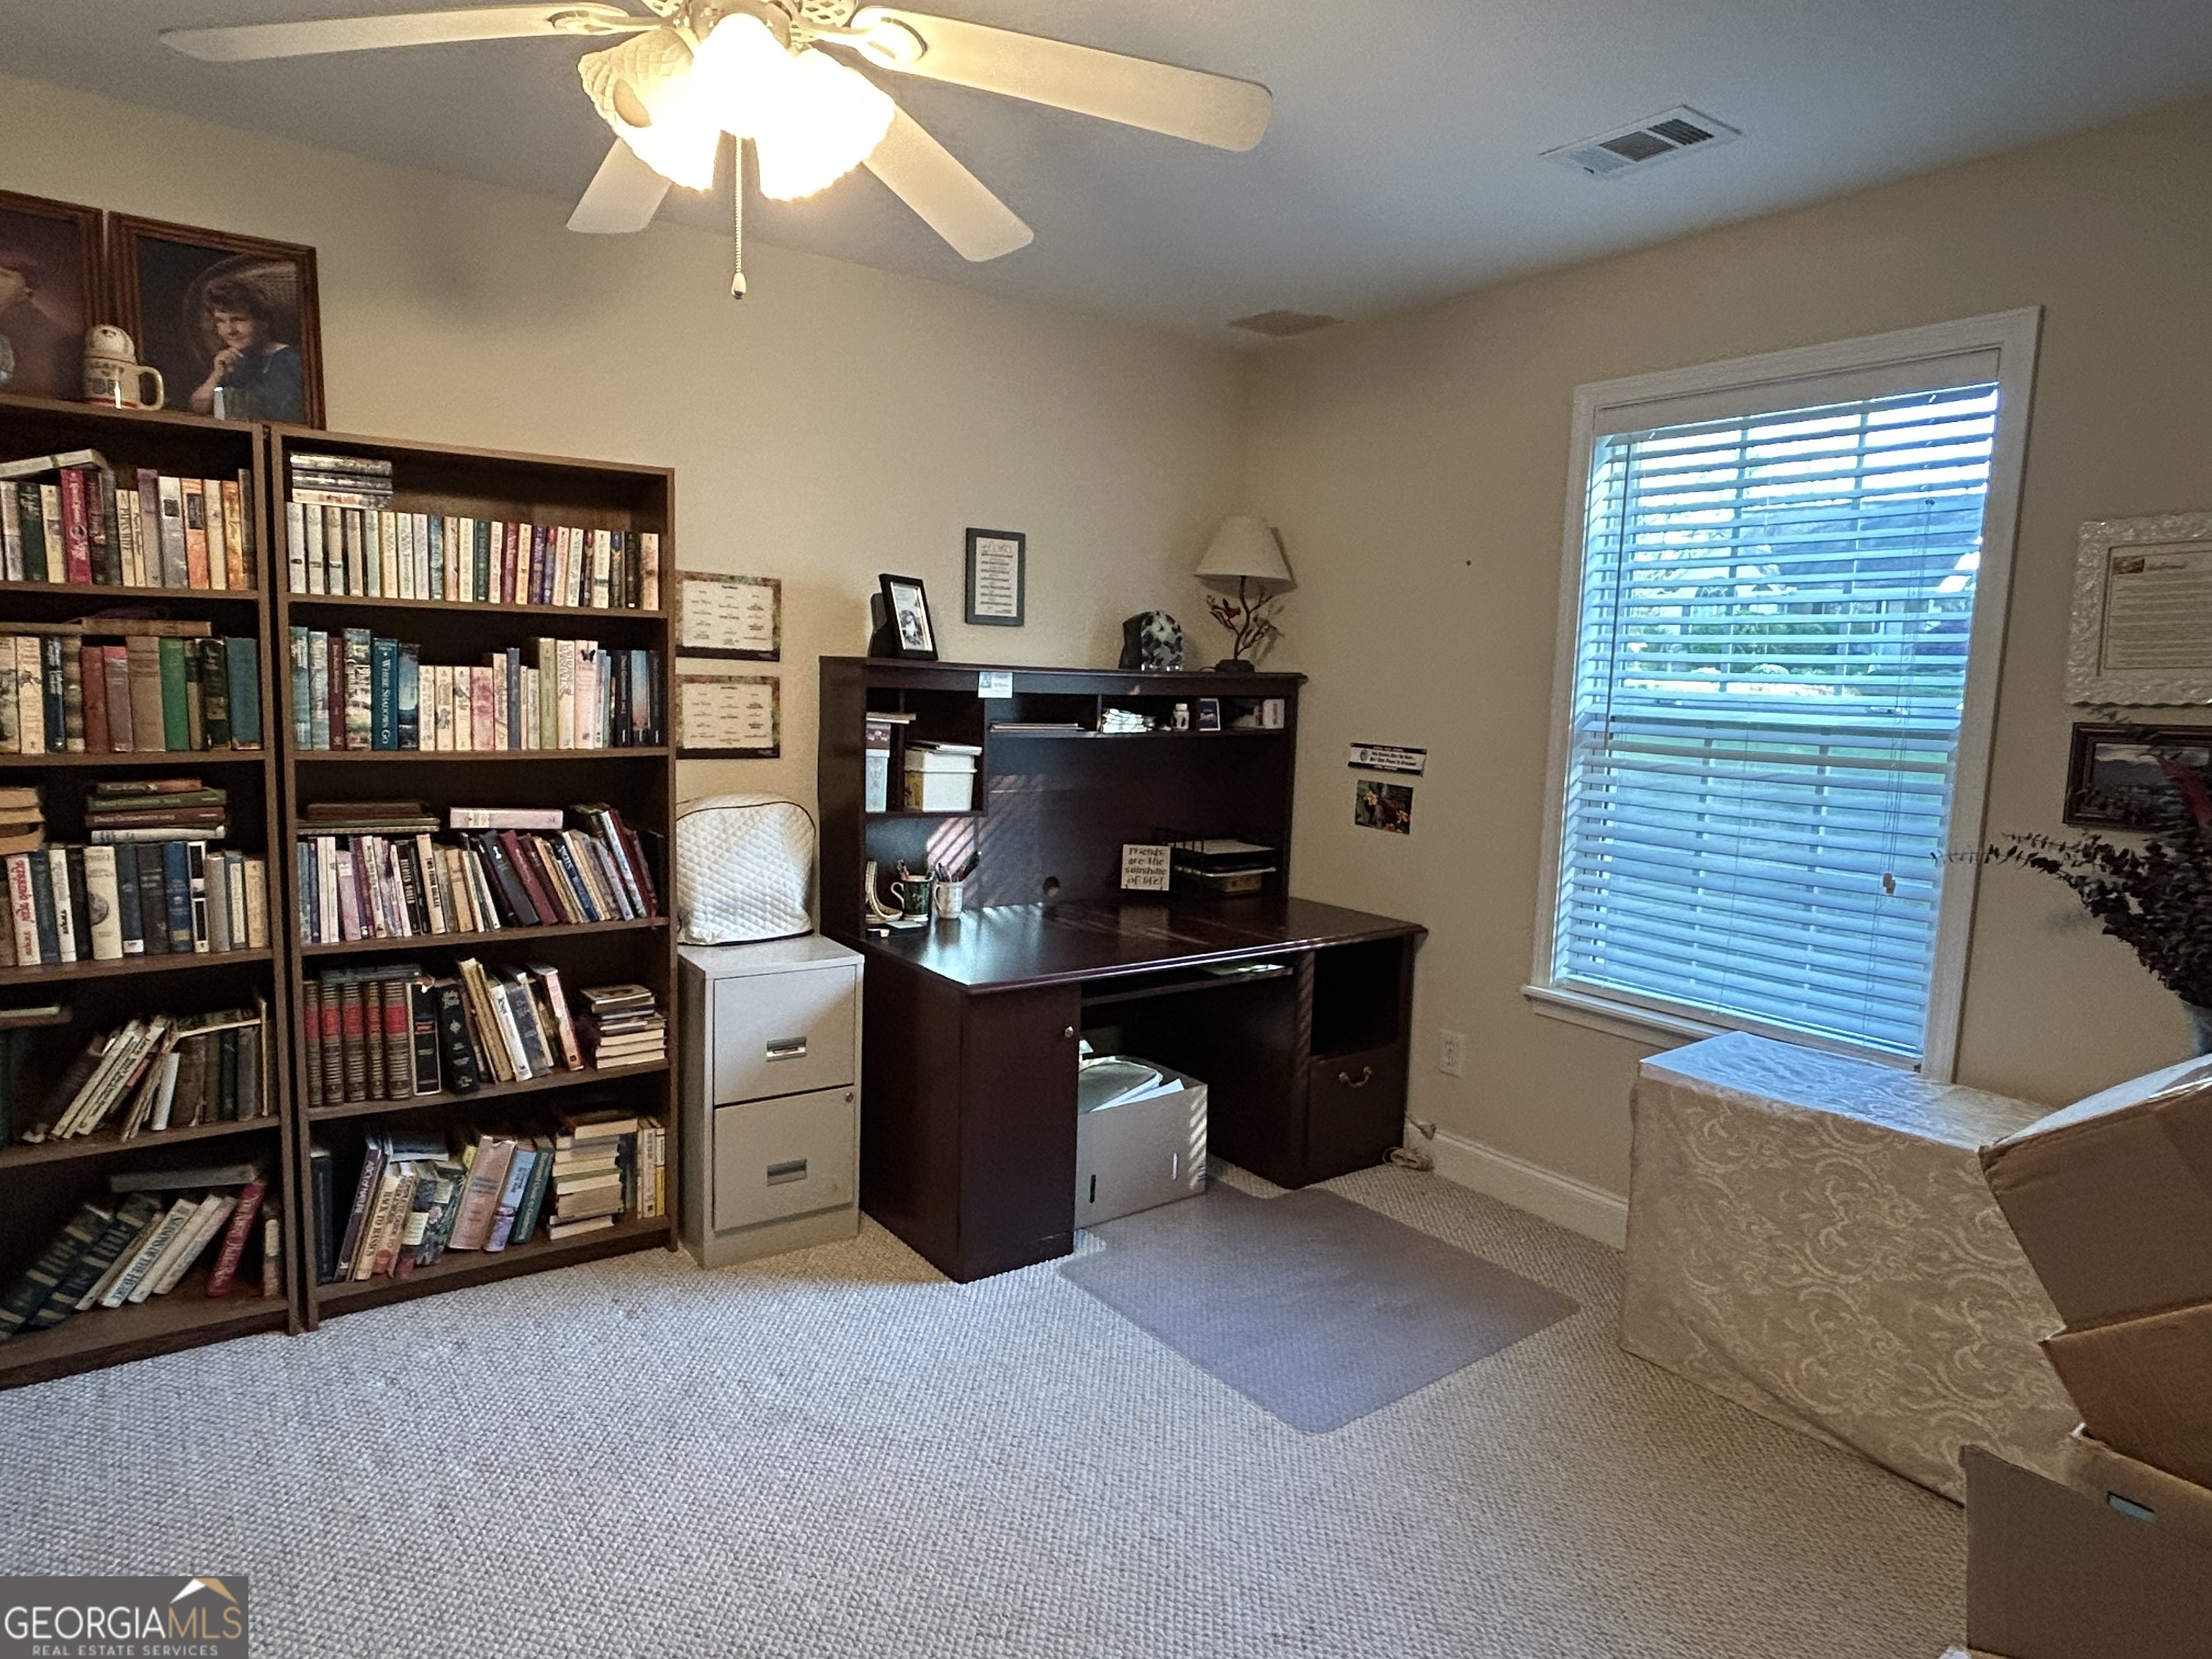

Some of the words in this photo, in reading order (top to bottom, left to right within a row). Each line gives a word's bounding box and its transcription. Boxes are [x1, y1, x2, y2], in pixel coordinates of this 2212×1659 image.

[382, 659, 391, 688] WHERE
[382, 688, 391, 728] SHADOWS
[1148, 857, 1164, 866] the
[1128, 876, 1141, 884] of
